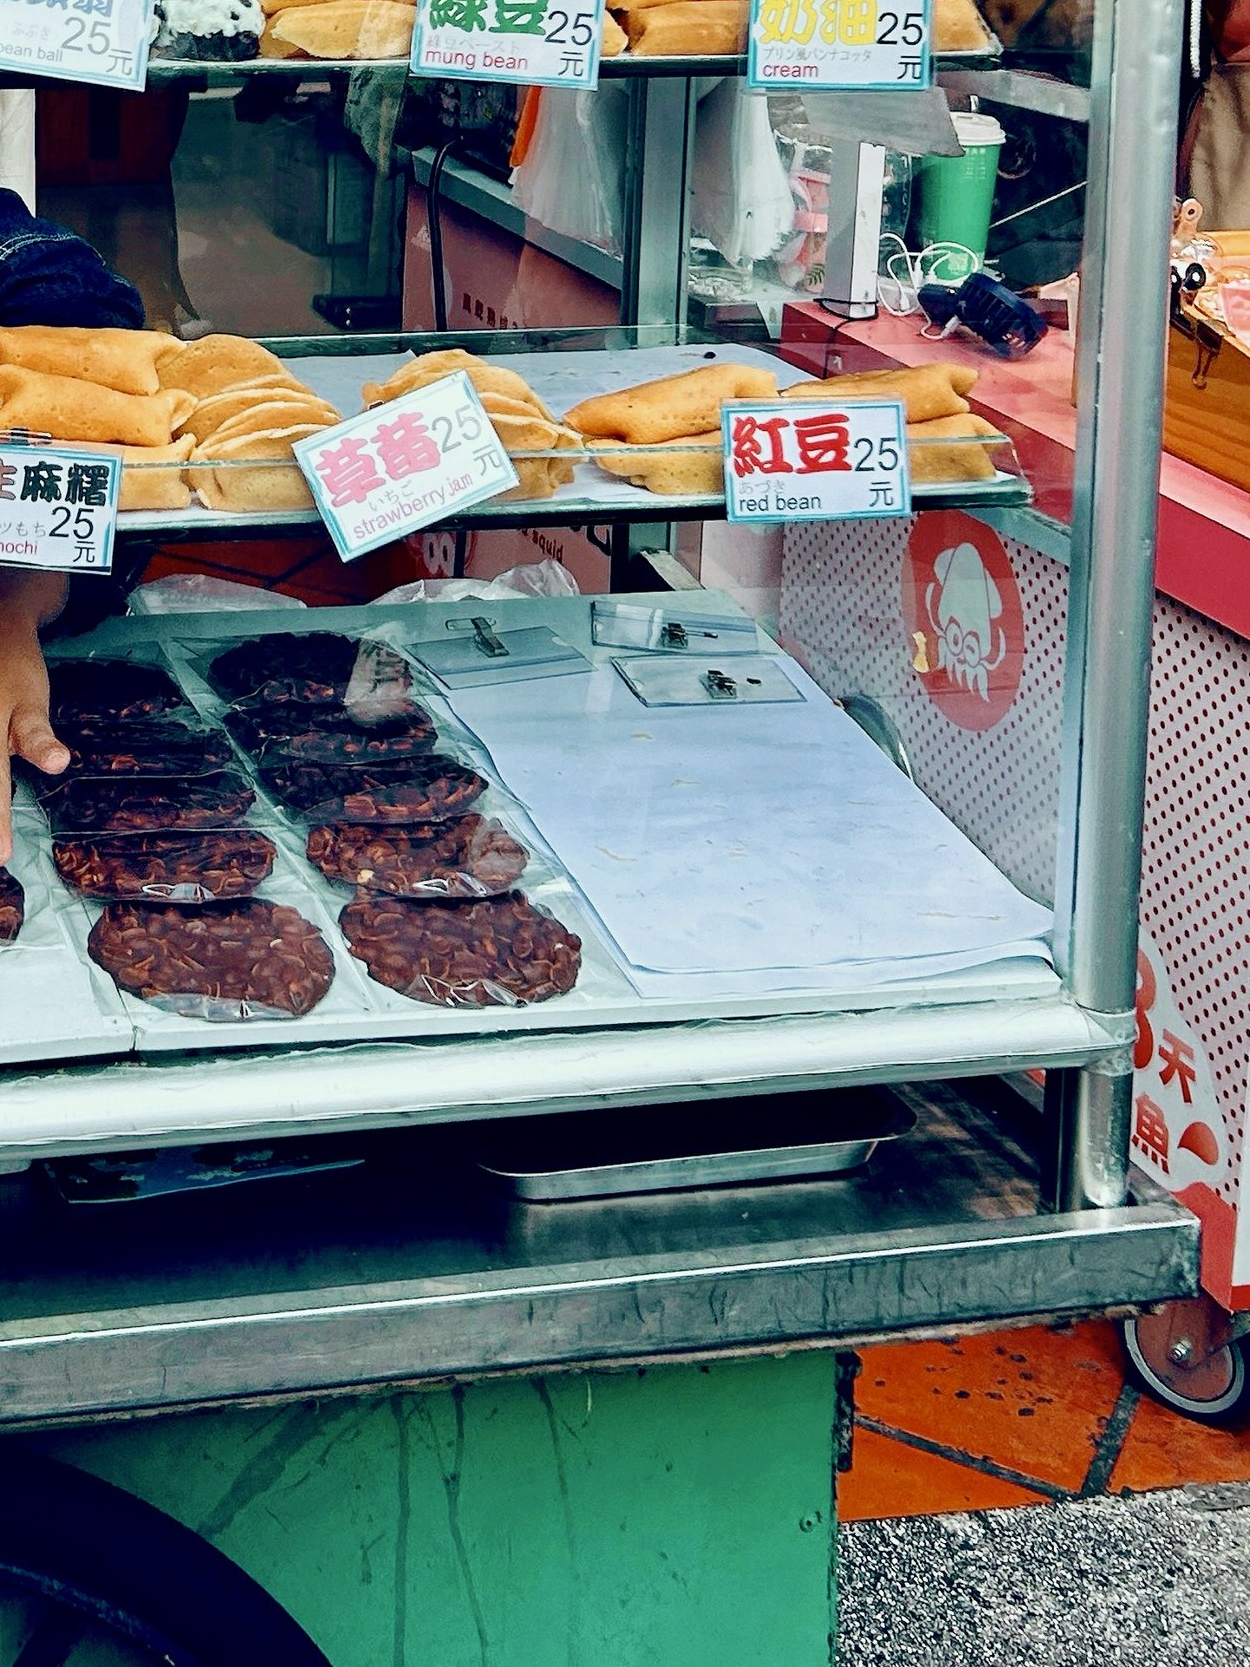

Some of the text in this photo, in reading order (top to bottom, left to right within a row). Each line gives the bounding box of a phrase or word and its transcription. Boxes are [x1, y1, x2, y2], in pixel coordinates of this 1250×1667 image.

[61, 17, 111, 55] 25
[545, 11, 594, 45] 25
[876, 12, 923, 45] 25
[37, 48, 63, 63] ball
[106, 48, 133, 76] 元
[425, 49, 528, 70] mung bean
[558, 51, 583, 77] 元
[763, 64, 819, 78] cream
[897, 55, 922, 79] 元
[431, 404, 482, 455] 25
[733, 413, 852, 477] 紅豆
[315, 412, 441, 507] 草莓
[472, 444, 502, 476] 元
[854, 437, 898, 472] 25
[353, 472, 473, 539] strawberry jam
[368, 480, 414, 512] いちご
[739, 494, 822, 512] red bean
[869, 482, 894, 507] 元
[49, 506, 94, 540] 25
[73, 541, 96, 563] 元
